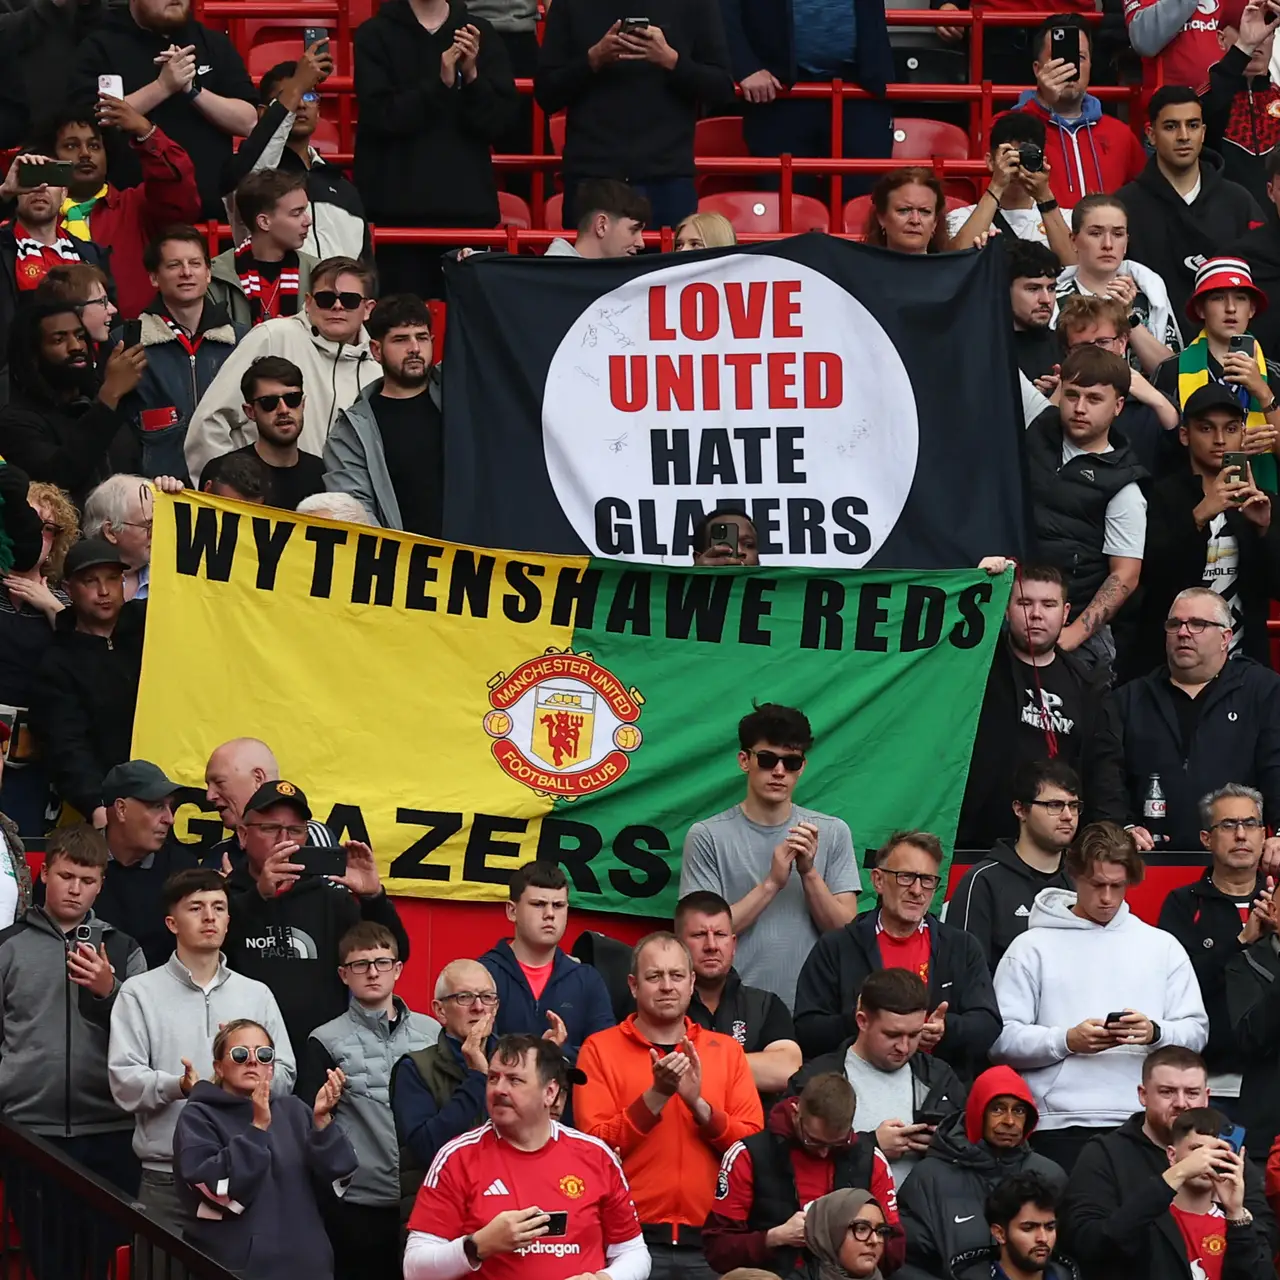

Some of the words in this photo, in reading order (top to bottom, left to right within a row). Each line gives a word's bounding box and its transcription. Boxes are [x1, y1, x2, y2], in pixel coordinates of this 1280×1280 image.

[647, 280, 804, 342] LOVE
[608, 351, 843, 412] UNITED
[649, 425, 808, 486] HATE
[593, 496, 872, 556] GLAERS
[173, 501, 778, 647] WYTHENSHAWE
[799, 578, 993, 655] REDS
[494, 658, 588, 708] MANCHESTER
[586, 664, 636, 717] UNITED
[500, 748, 576, 792] FOOTBALL
[577, 760, 618, 790] CLUB
